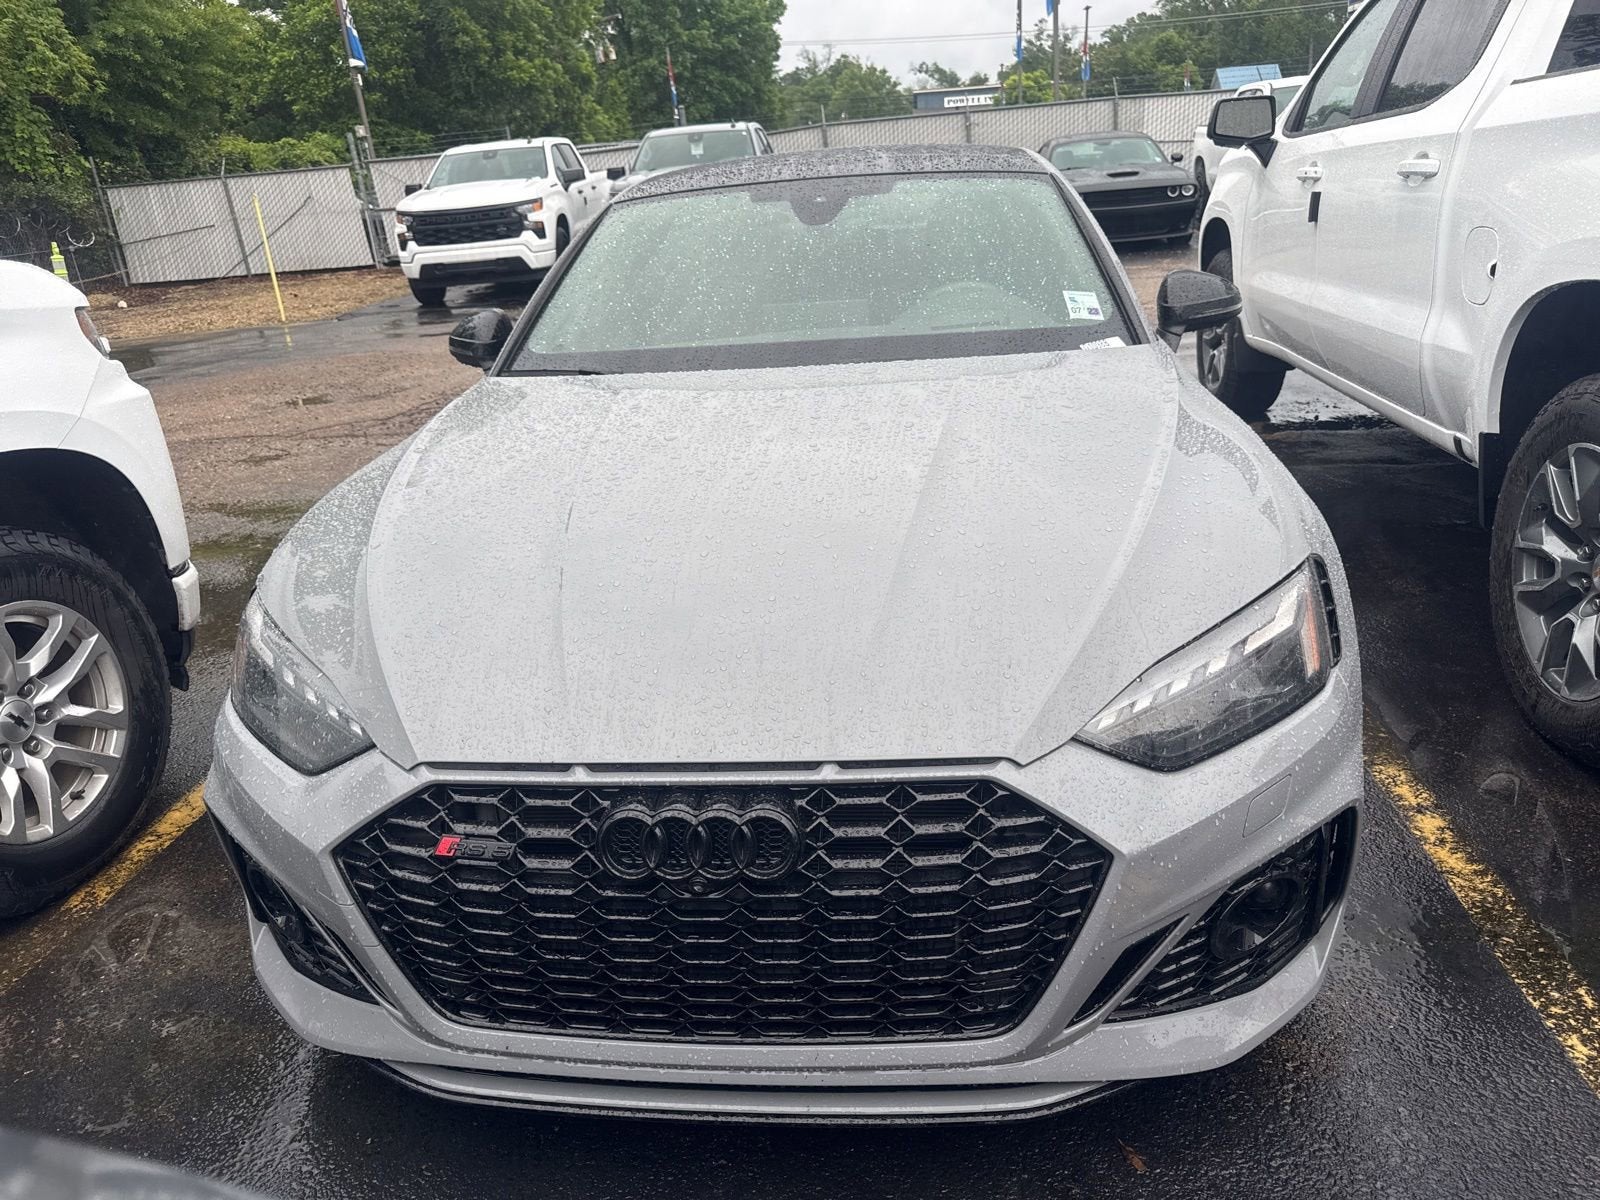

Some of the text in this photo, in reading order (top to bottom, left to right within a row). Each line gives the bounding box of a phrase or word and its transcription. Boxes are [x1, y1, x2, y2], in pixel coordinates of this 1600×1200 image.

[1071, 306, 1082, 314] 07
[447, 842, 511, 858] RS 5
